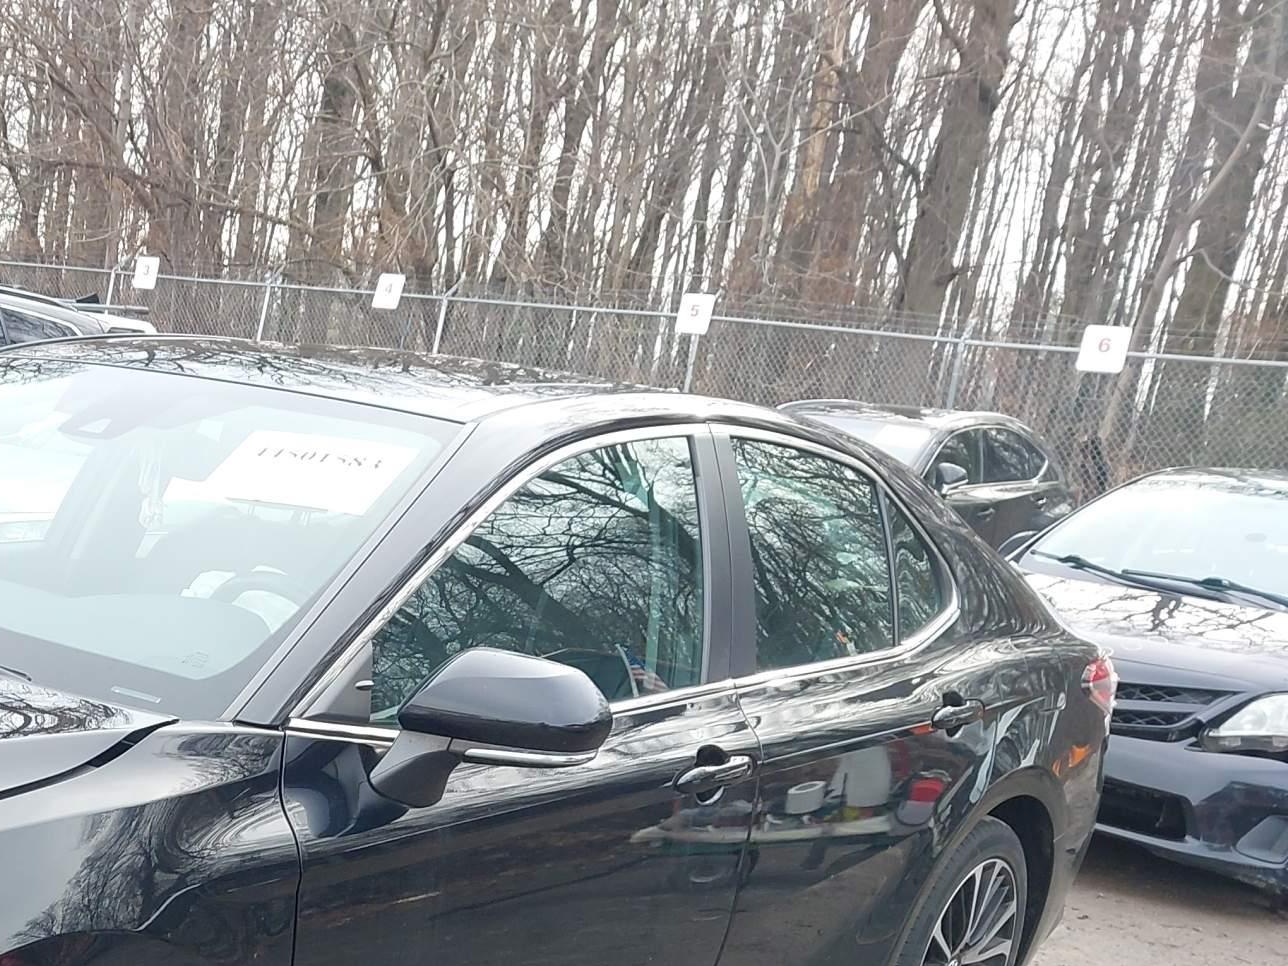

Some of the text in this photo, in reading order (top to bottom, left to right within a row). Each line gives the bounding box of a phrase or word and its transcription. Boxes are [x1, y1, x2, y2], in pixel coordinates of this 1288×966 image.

[142, 264, 151, 276] 3
[690, 304, 700, 317] 5
[1097, 338, 1111, 352] 6
